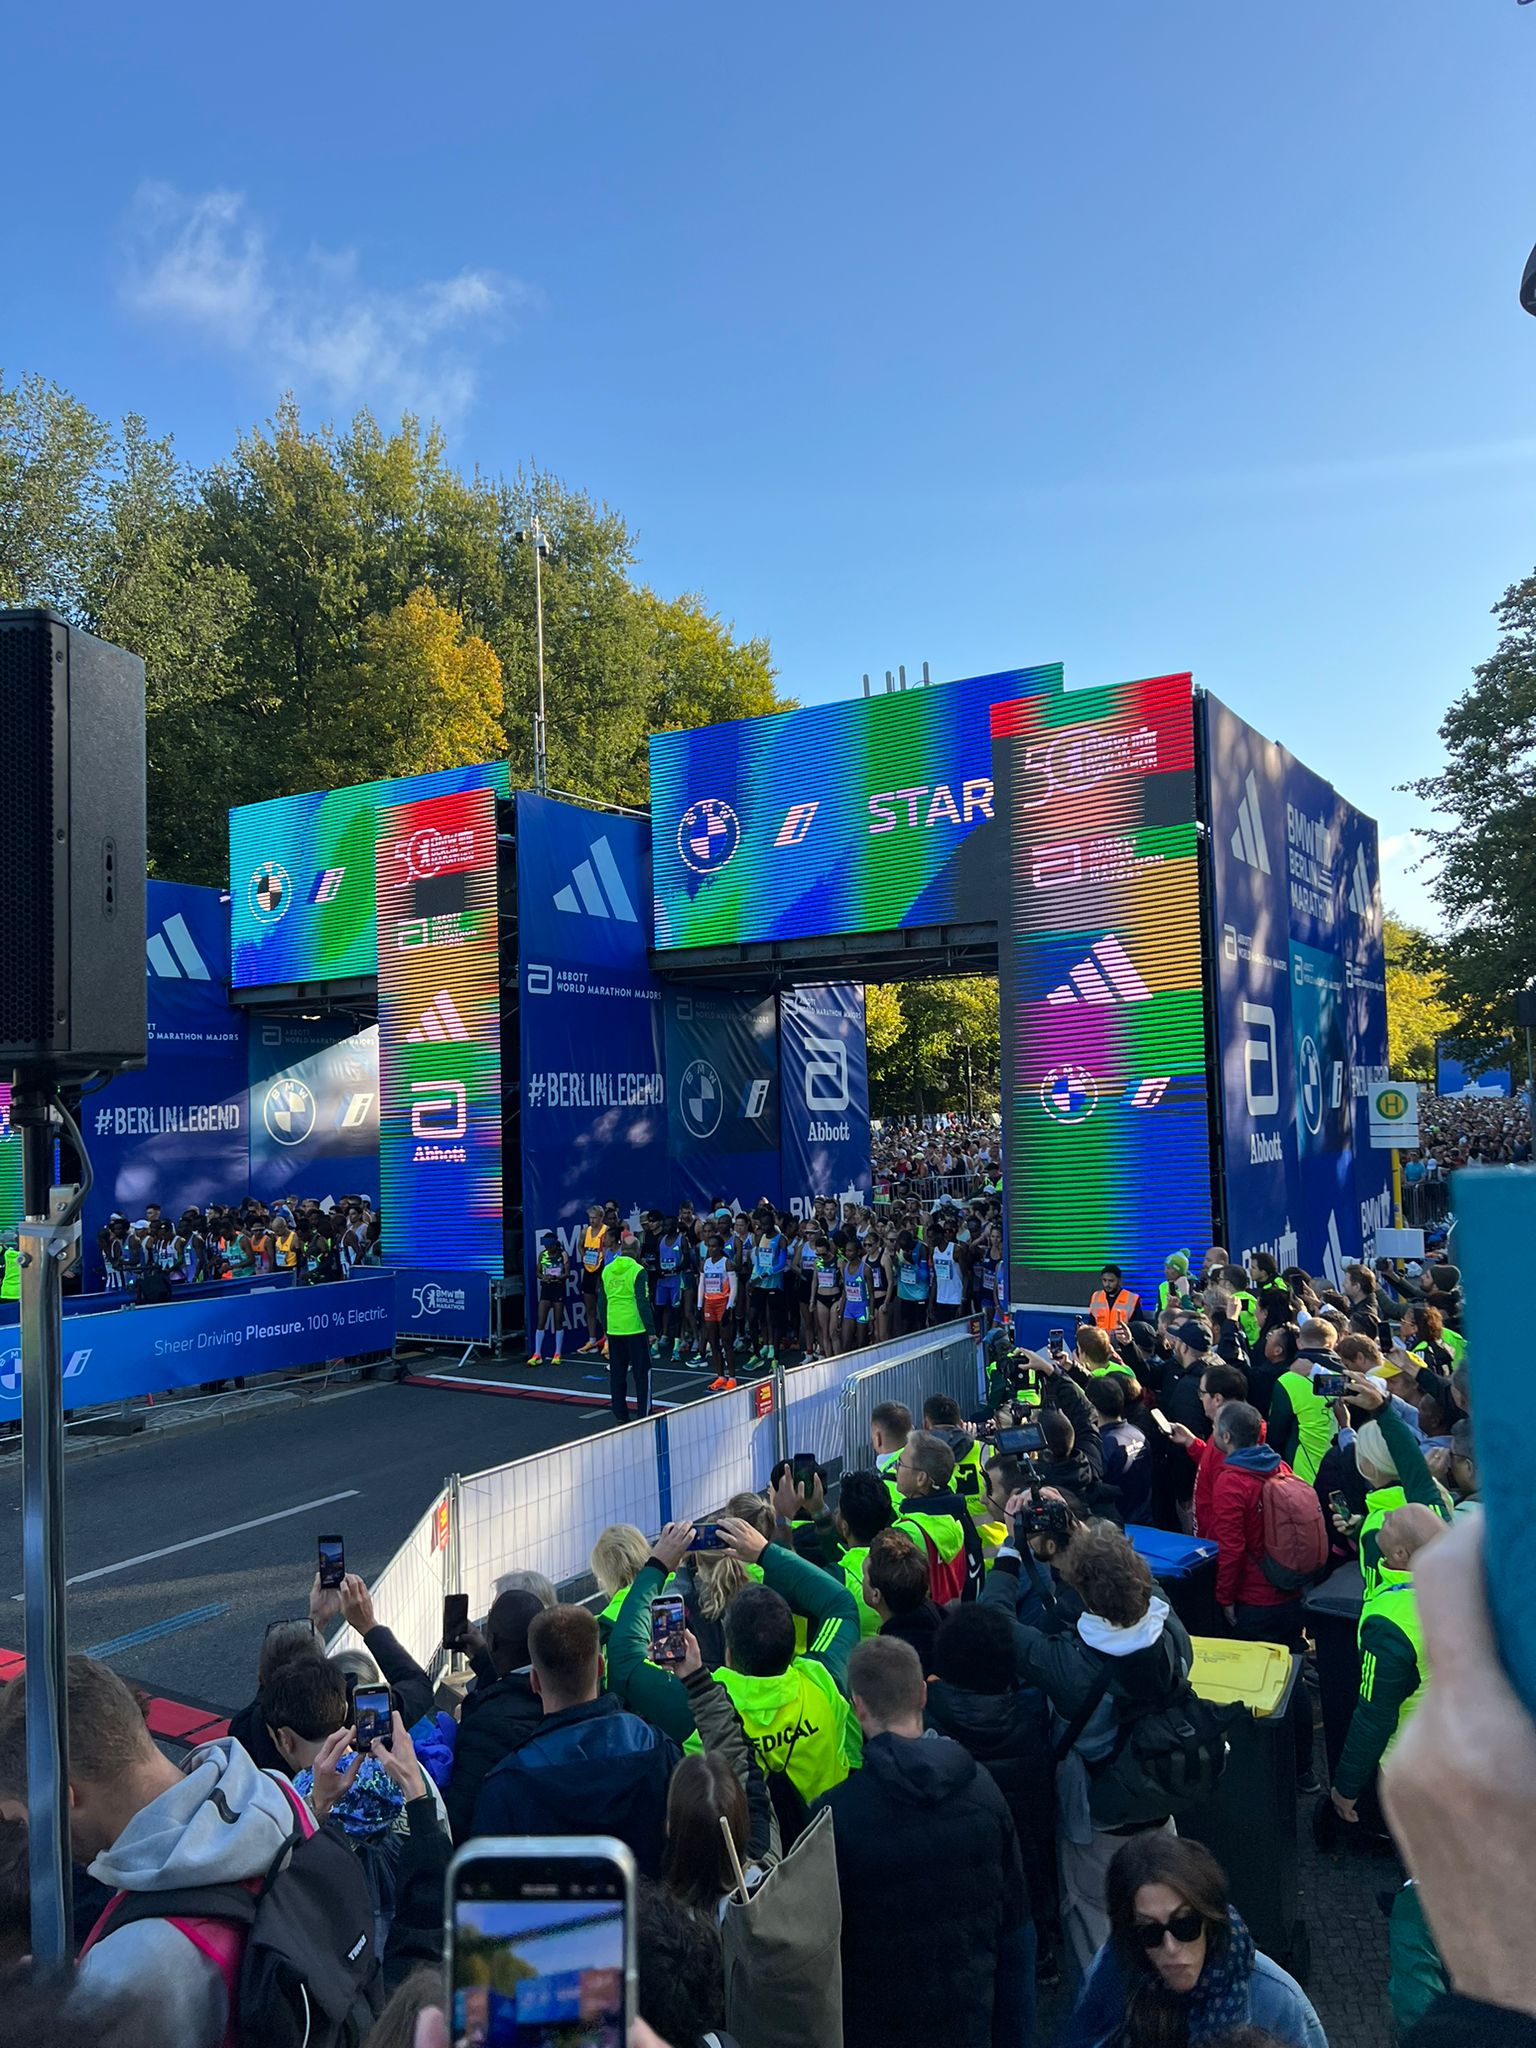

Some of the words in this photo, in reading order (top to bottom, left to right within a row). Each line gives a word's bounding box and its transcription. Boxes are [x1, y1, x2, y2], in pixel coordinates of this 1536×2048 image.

[869, 779, 995, 835] STAR
[1286, 802, 1316, 858] BMW
[1288, 846, 1320, 888] BERLIN
[1290, 880, 1335, 924] MARATHON
[556, 971, 589, 983] ABBOTT
[556, 982, 586, 994] WORLD
[587, 985, 632, 998] MARATHON
[634, 990, 662, 1000] MAJORS
[156, 1032, 203, 1042] MARATHON
[205, 1033, 240, 1042] MAJORS
[270, 1082, 309, 1101] BMW
[528, 1072, 664, 1108] #BERLINLEGEND
[685, 1063, 718, 1086] BMW
[94, 1104, 240, 1136] #BERLINLEGEND
[807, 1121, 851, 1142] Abbott
[1250, 1131, 1283, 1165] Abbott
[1360, 1196, 1382, 1239] BMW
[411, 1283, 442, 1318] 50
[435, 1289, 455, 1299] BMW
[435, 1303, 465, 1311] MARATHON
[154, 1337, 194, 1356] Sheer
[197, 1329, 242, 1349] Driving
[245, 1320, 305, 1340] Pleasure.
[307, 1314, 329, 1331] 100
[332, 1312, 345, 1327] %
[347, 1306, 388, 1325] Electric.
[750, 1718, 820, 1753] EDICAL
